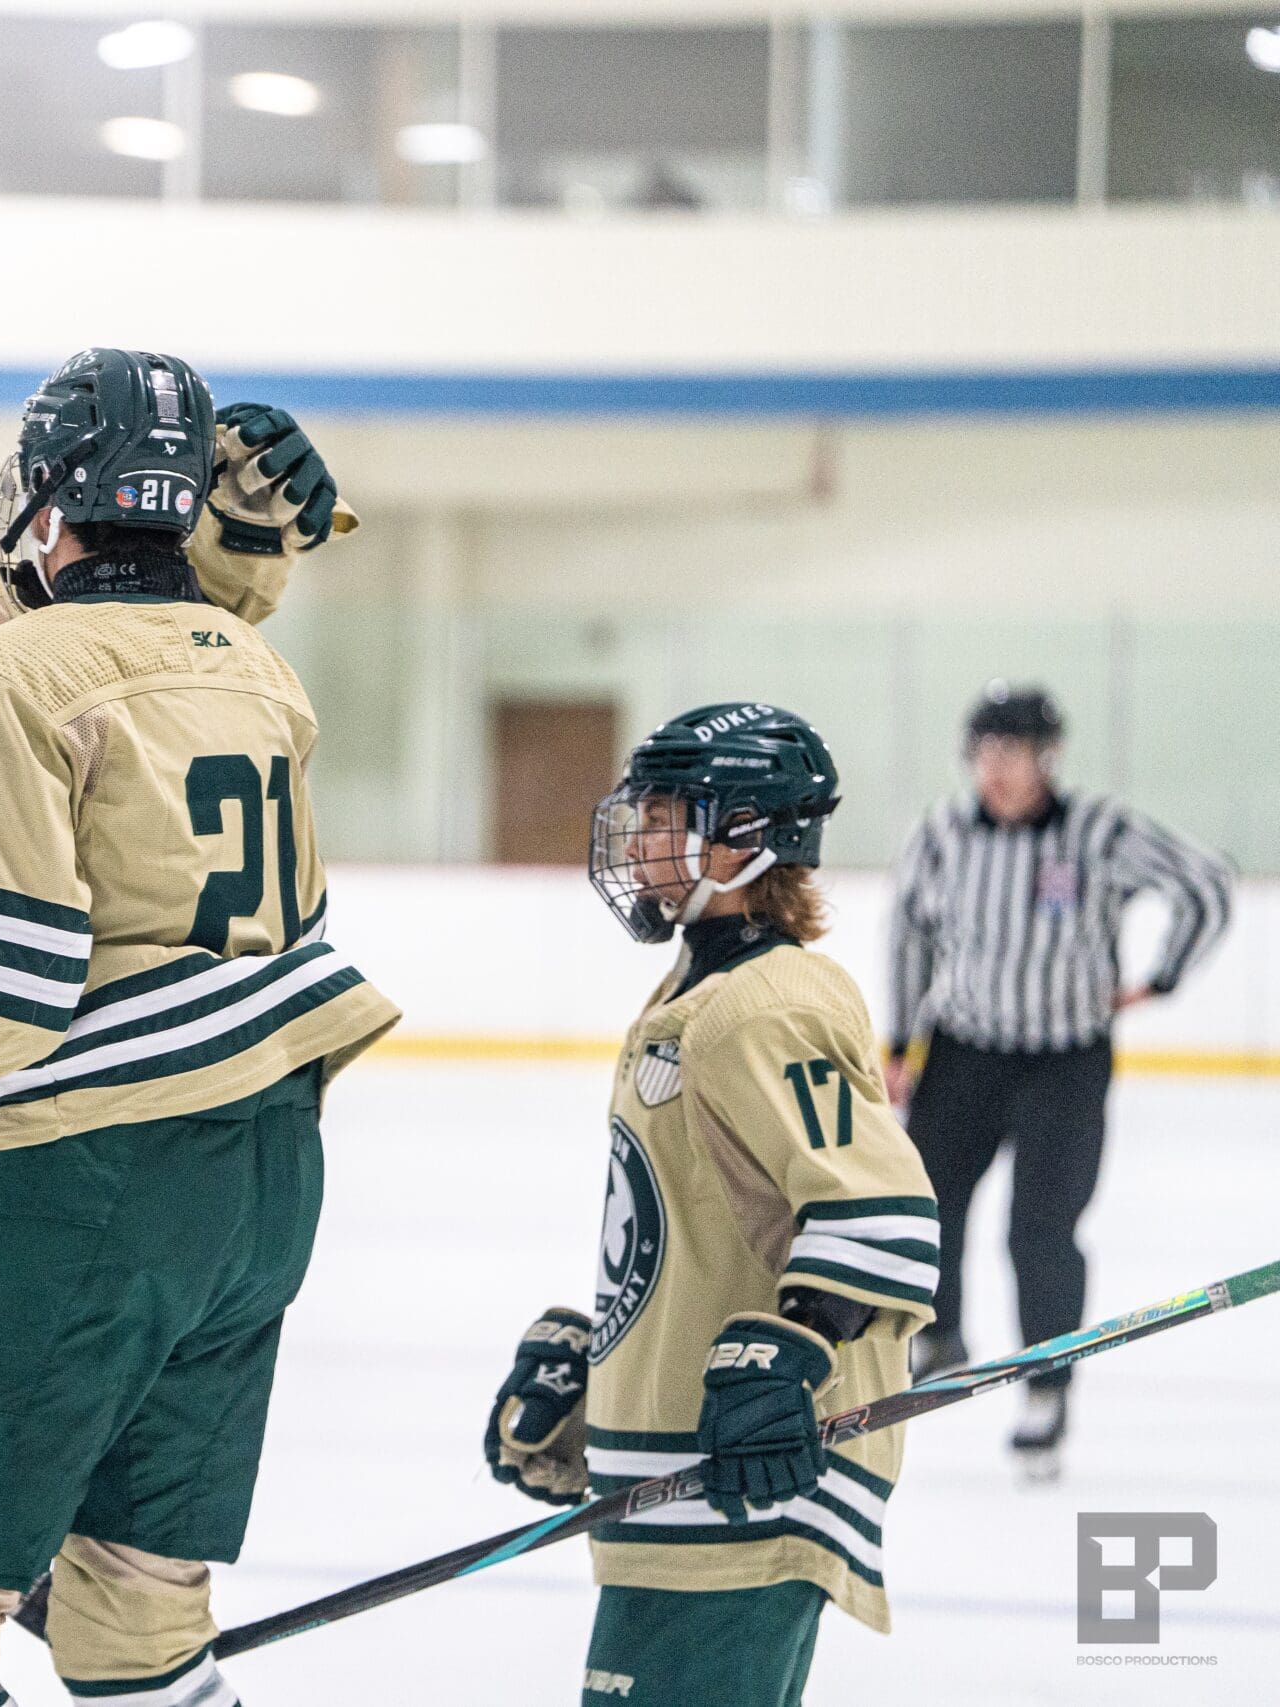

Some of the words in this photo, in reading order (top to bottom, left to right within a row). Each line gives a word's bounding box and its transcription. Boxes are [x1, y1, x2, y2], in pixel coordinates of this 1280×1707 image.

[141, 479, 171, 511] 21
[191, 630, 233, 648] SKA
[694, 703, 775, 743] DUKES
[184, 753, 302, 957] 21
[784, 1058, 852, 1150] 17
